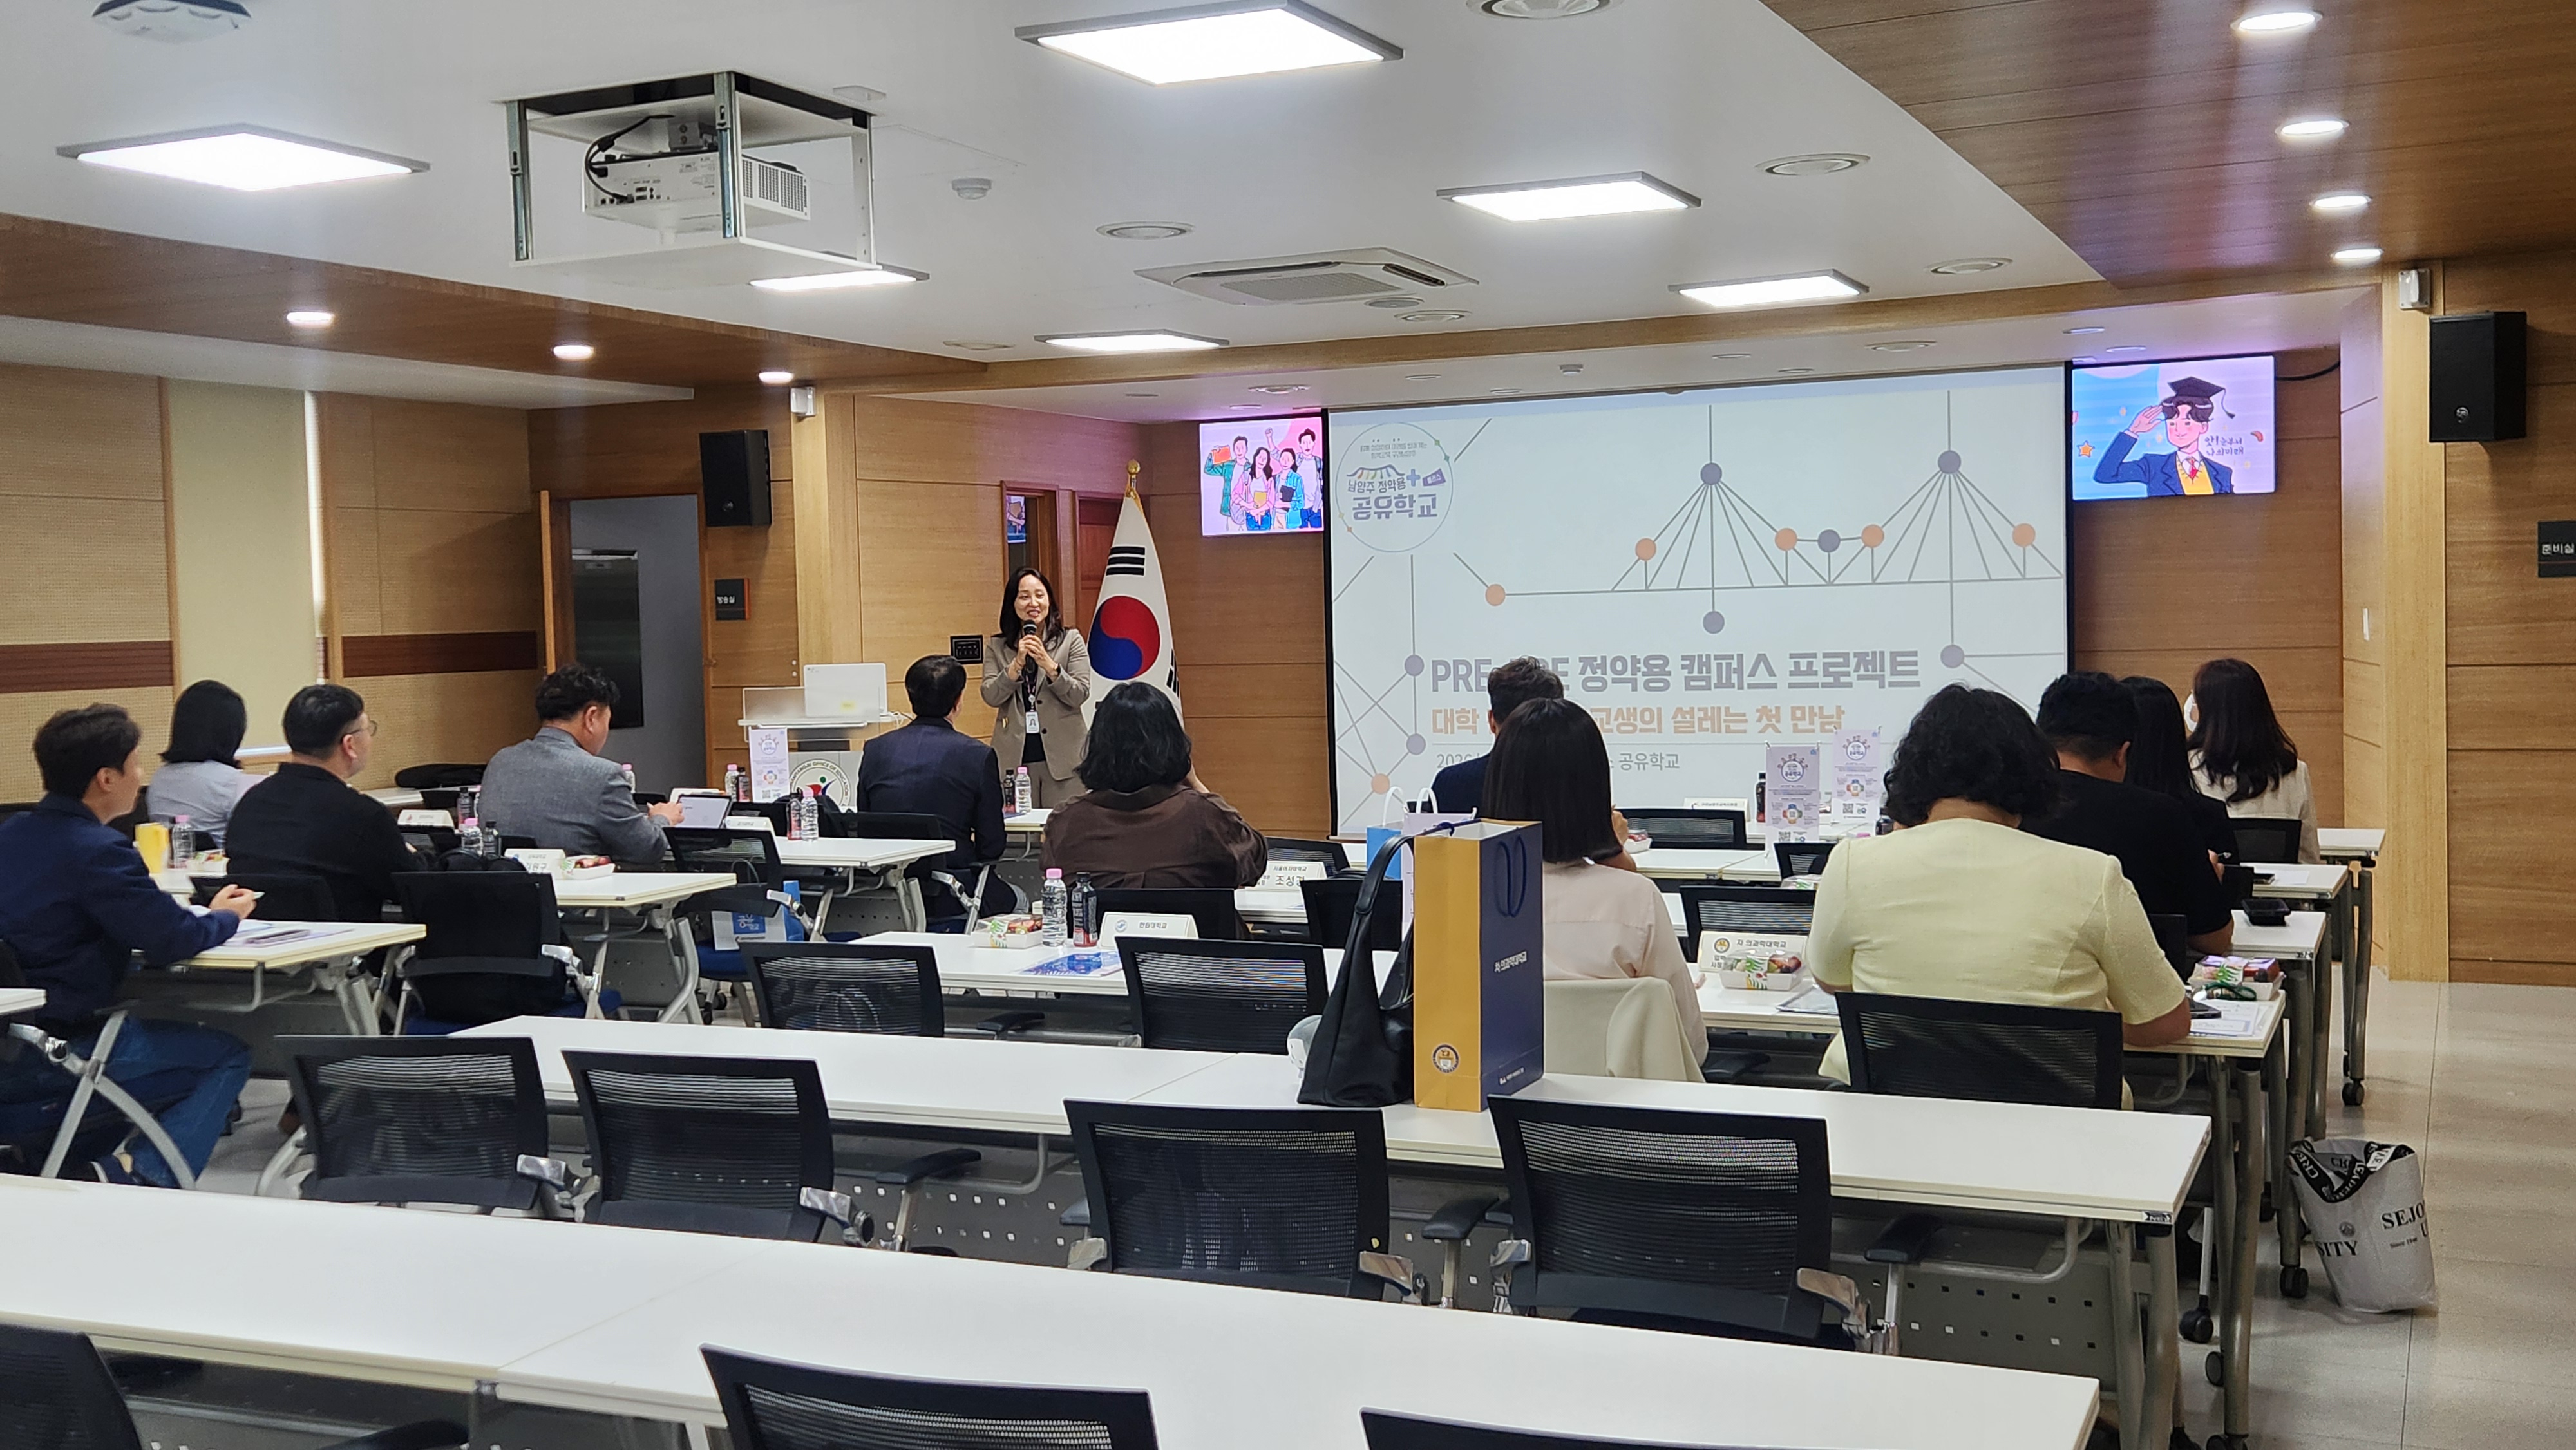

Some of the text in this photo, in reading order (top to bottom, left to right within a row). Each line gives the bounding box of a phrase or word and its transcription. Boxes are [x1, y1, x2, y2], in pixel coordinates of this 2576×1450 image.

[1348, 476, 1406, 494] 남양주 정약용
[1352, 493, 1438, 521] 공유학교
[2541, 543, 2575, 555] 준비실
[1431, 658, 1492, 693] PRE
[1578, 654, 1672, 693] 정약용
[1680, 653, 1778, 692] 캠퍼스
[1787, 650, 1922, 690] 프로젝트
[1432, 708, 1480, 735] 대학
[1671, 706, 1749, 734] 설레는
[1755, 705, 1782, 734] 첫
[1790, 705, 1846, 734] 만남
[1618, 751, 1680, 771] 공유학교
[2382, 1200, 2425, 1229] SEJO
